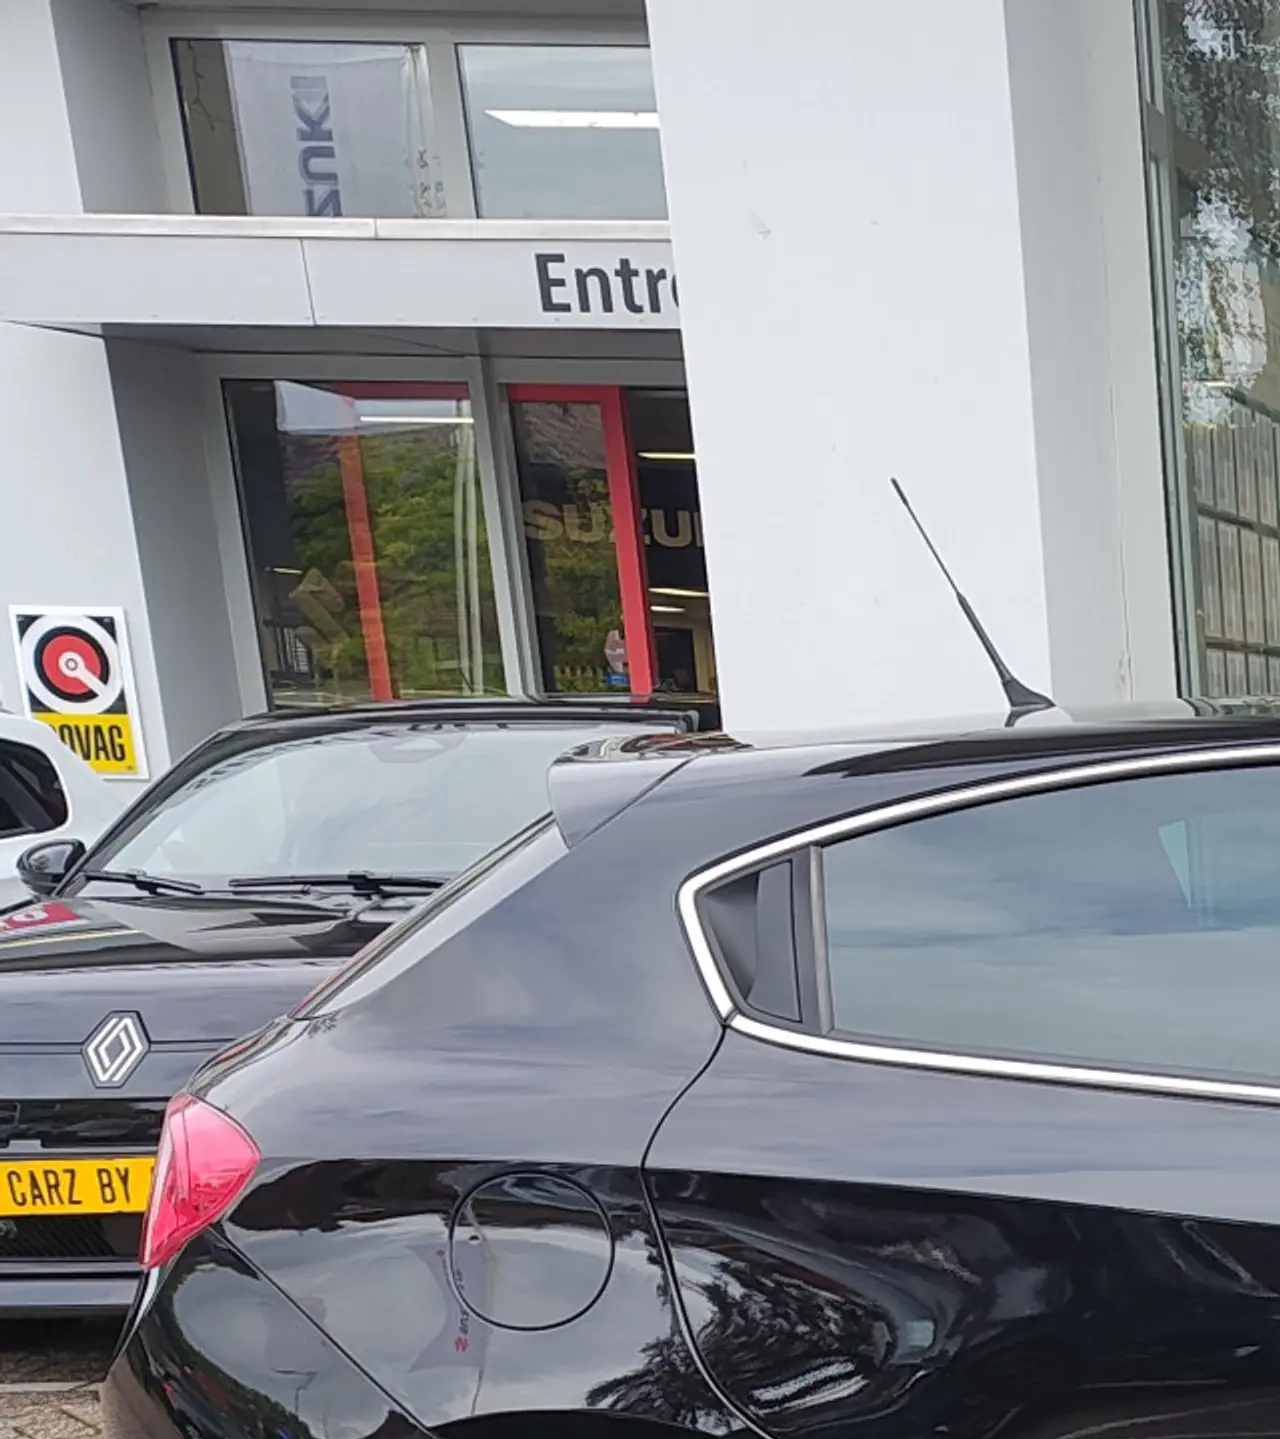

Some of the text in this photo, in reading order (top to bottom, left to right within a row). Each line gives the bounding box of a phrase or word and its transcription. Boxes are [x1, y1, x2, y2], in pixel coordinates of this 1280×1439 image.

[522, 499, 705, 549] SUU
[50, 723, 127, 762] OVAG
[7, 1168, 82, 1207] CARZ
[96, 1166, 130, 1204] BY
